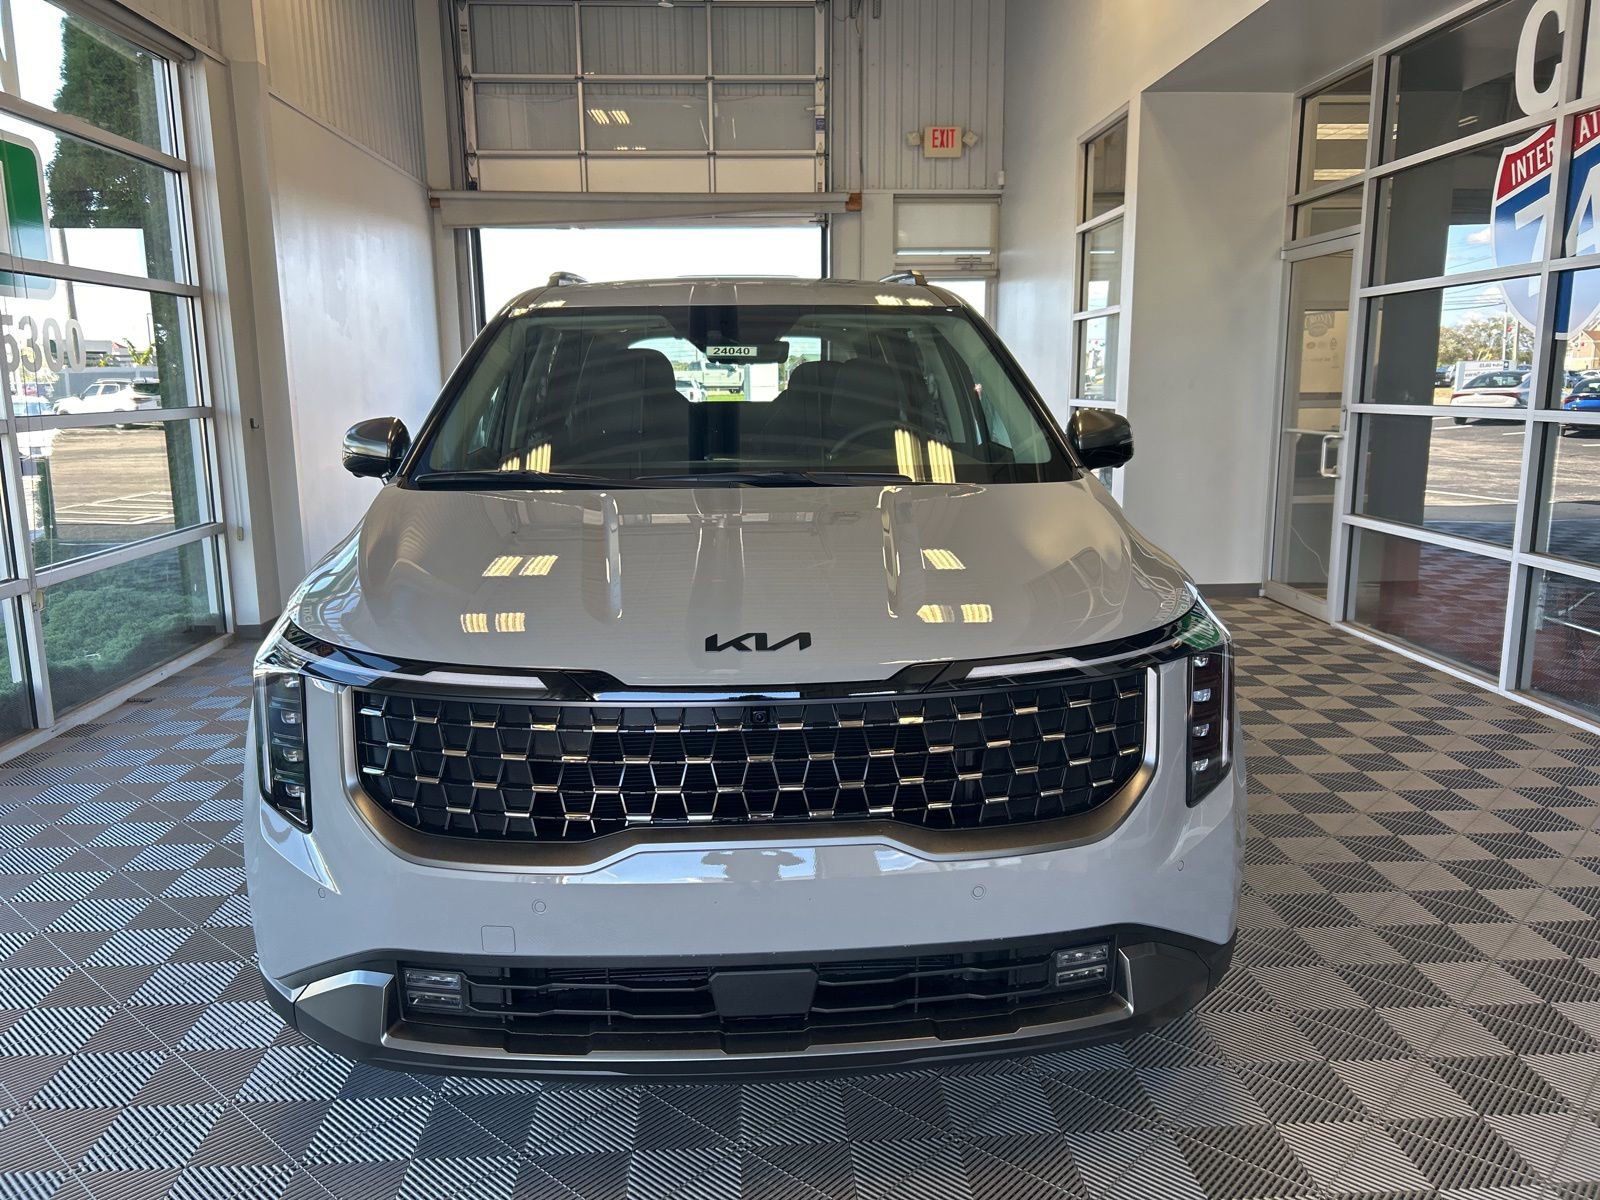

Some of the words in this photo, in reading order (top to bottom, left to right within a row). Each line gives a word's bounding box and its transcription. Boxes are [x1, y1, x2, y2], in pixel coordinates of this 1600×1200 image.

[932, 128, 956, 149] EXIT
[713, 347, 751, 355] 24040
[705, 632, 812, 652] KIA
